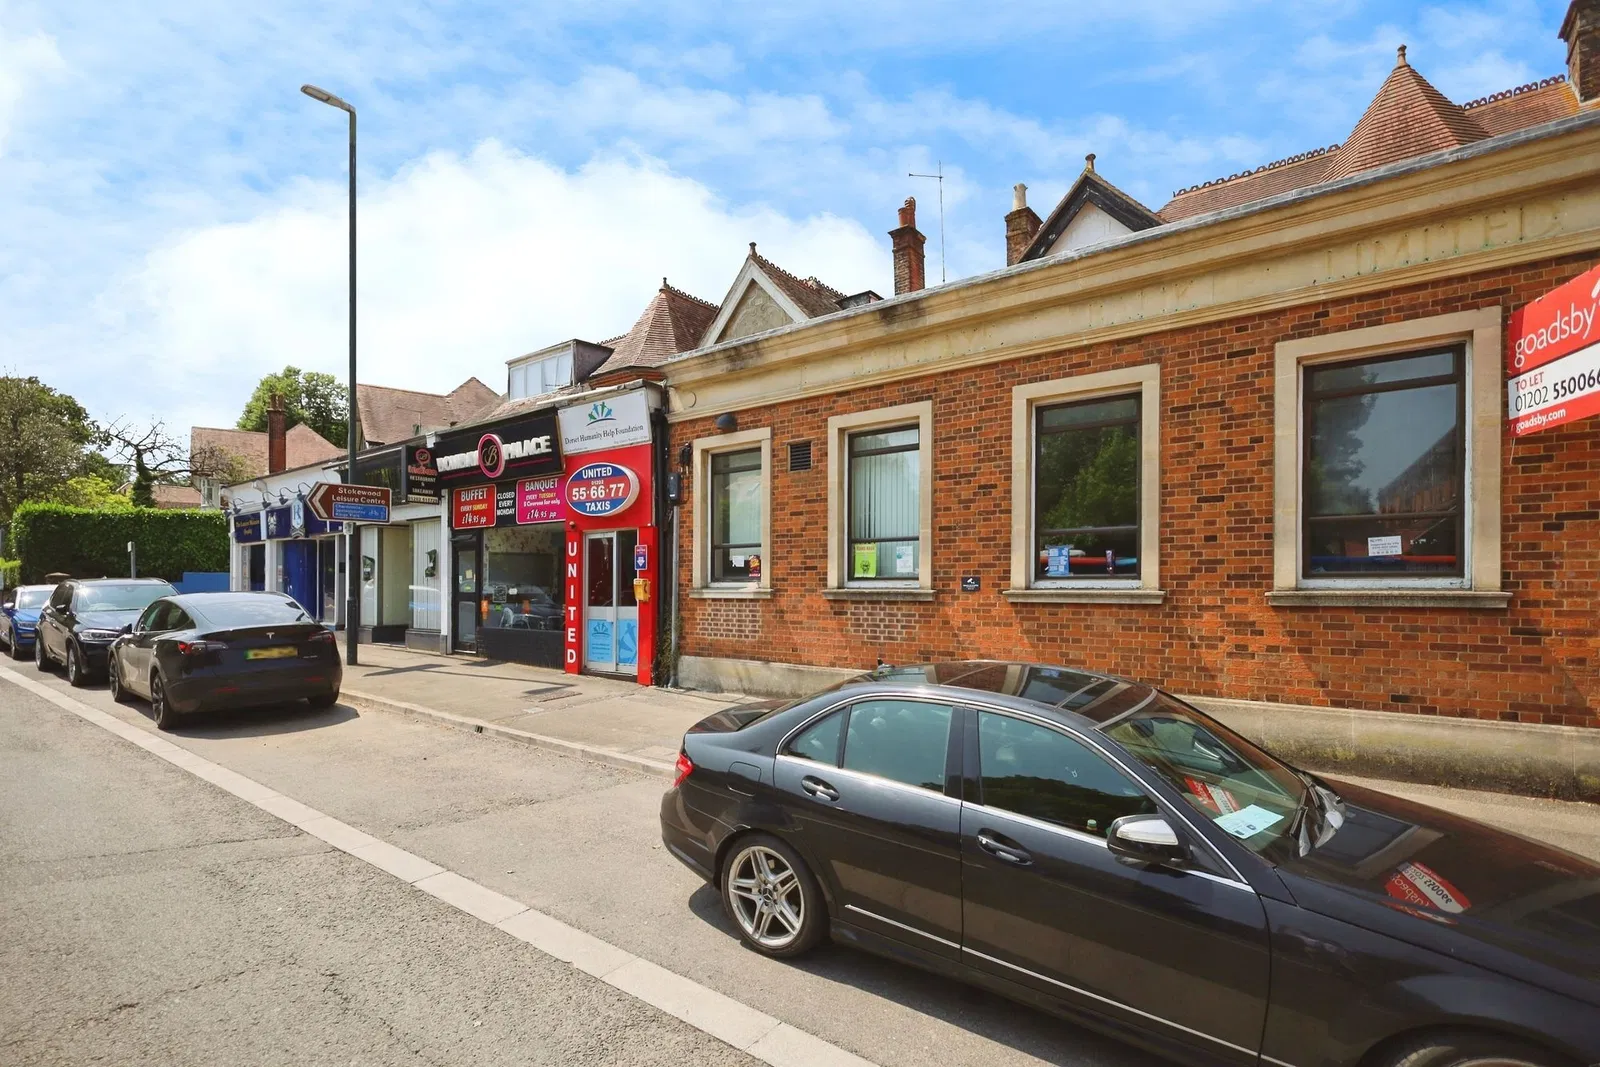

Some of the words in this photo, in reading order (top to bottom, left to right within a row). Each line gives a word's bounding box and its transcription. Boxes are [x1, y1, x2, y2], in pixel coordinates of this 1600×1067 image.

[1514, 302, 1596, 368] goadsby
[1515, 378, 1528, 393] TO
[1529, 371, 1544, 388] LET
[1515, 386, 1549, 412] 01202
[1515, 407, 1566, 433] goadsby.com
[564, 437, 580, 445] Dorset
[580, 432, 602, 442] Humanity
[603, 428, 615, 438] Help
[615, 425, 643, 435] Foundation
[503, 435, 552, 460] PALACE
[582, 466, 614, 479] UNITED
[525, 478, 558, 492] BANQUET
[338, 487, 381, 497] Stokewood
[461, 488, 488, 502] BUFFET
[497, 491, 515, 500] CLOSED
[332, 494, 359, 503] Leisure
[361, 496, 386, 505] Centre
[499, 500, 513, 508] EVERY
[551, 499, 561, 507] only
[472, 503, 488, 511] SUNDAY
[497, 507, 515, 515] MONDAY
[585, 501, 611, 512] TAXIS
[567, 541, 577, 664] UNITED
